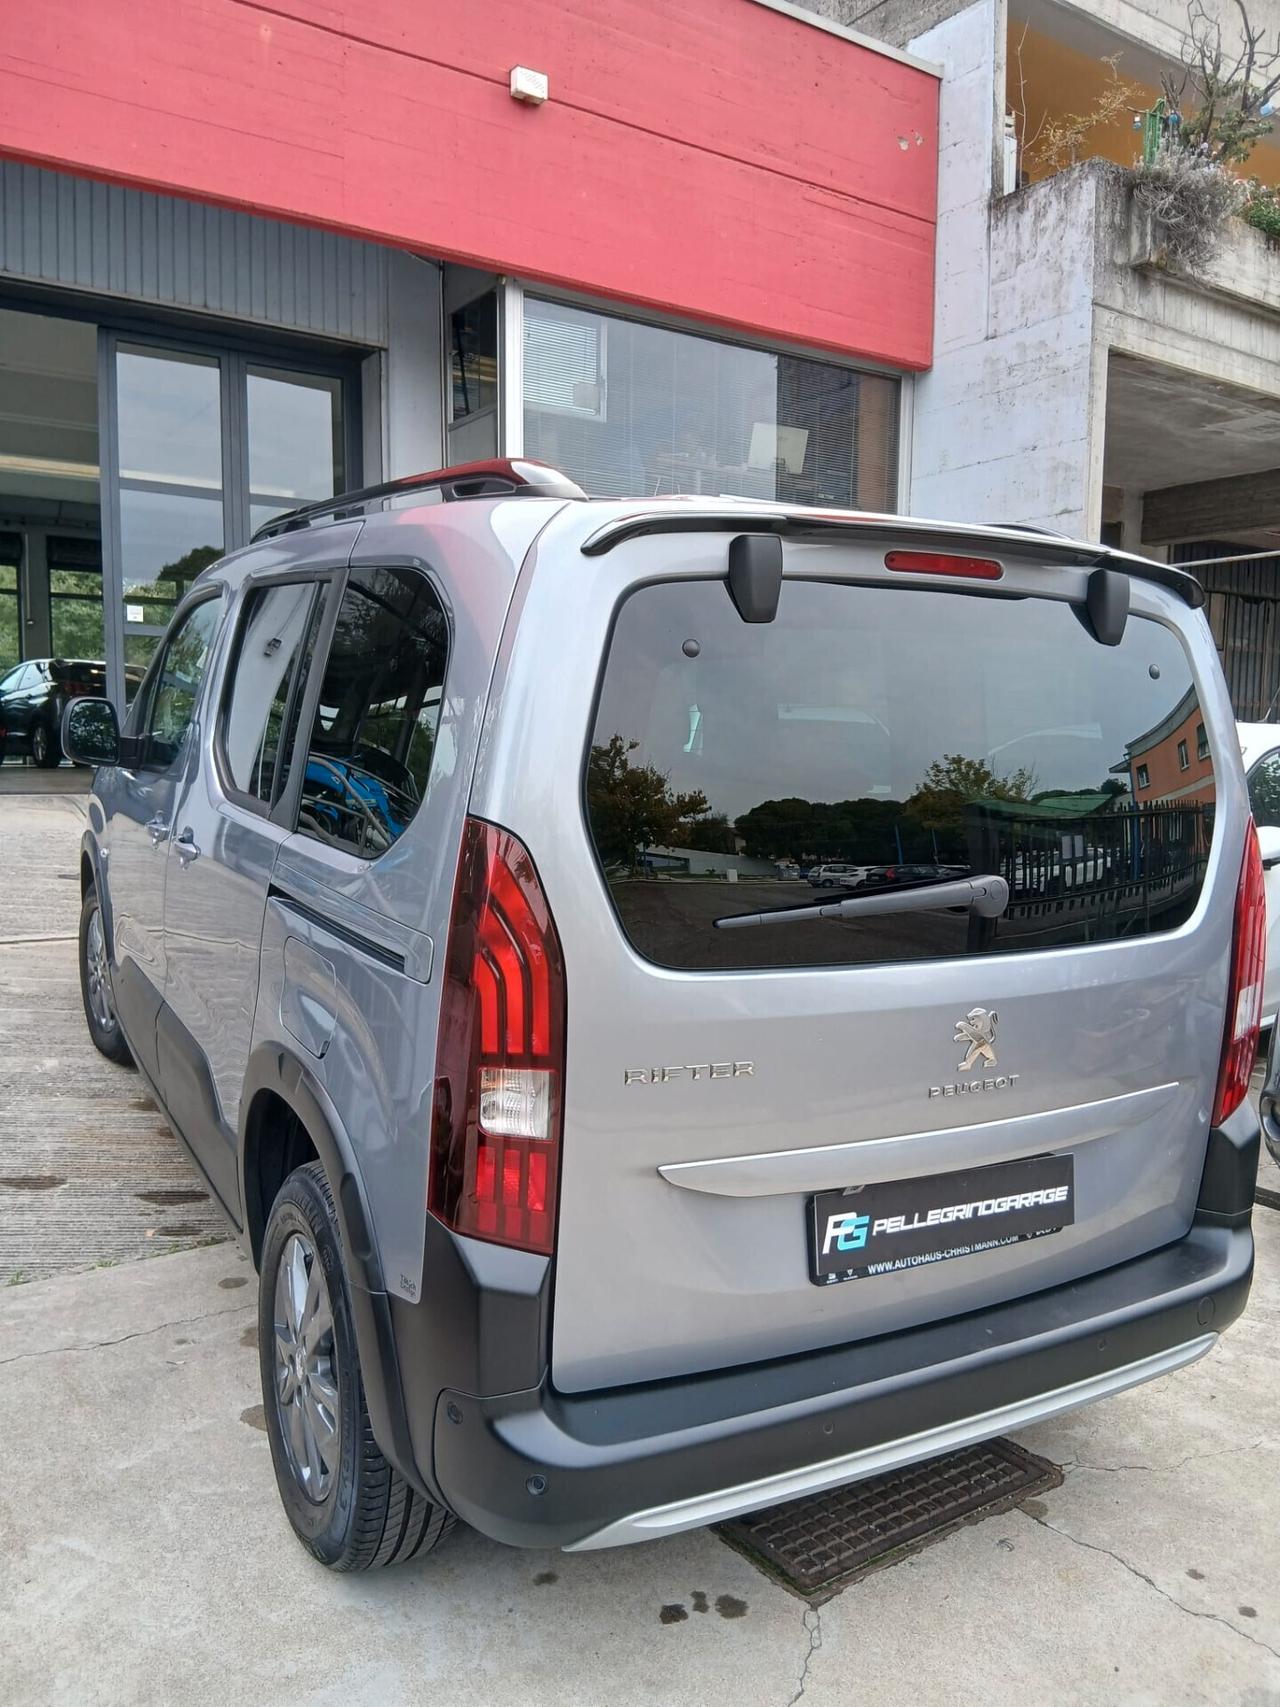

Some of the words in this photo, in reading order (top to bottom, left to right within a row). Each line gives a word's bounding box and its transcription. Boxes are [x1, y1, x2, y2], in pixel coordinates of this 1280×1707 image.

[624, 1060, 756, 1086] RIFTER
[928, 1074, 1020, 1099] PEUGEOT
[872, 1185, 1070, 1236] PELLEGRINOGARAGE
